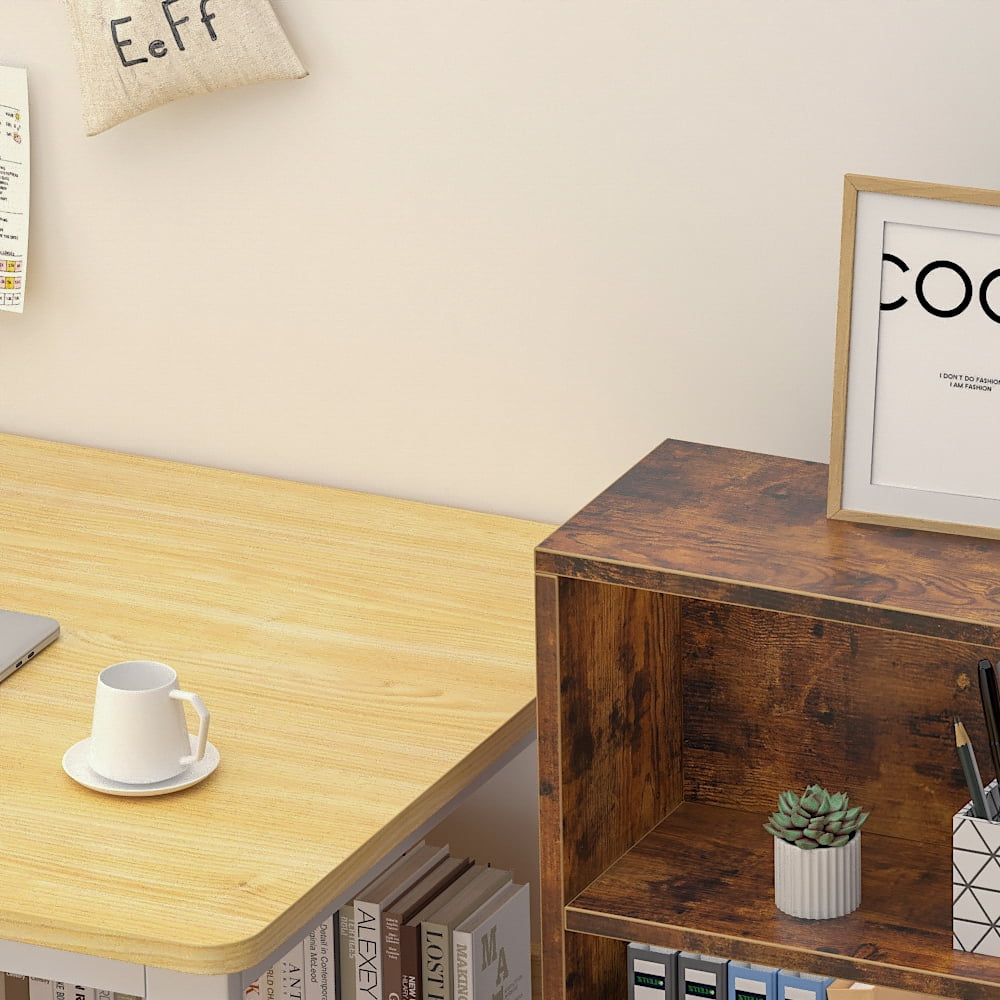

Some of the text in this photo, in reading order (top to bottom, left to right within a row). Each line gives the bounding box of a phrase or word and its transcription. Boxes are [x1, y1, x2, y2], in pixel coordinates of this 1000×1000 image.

[943, 373, 963, 381] DON'T
[965, 383, 992, 392] FASHION
[357, 907, 378, 1000] ALEXEY
[426, 930, 444, 989] LOST
[310, 952, 318, 983] McLeod
[408, 975, 417, 998] NEW
